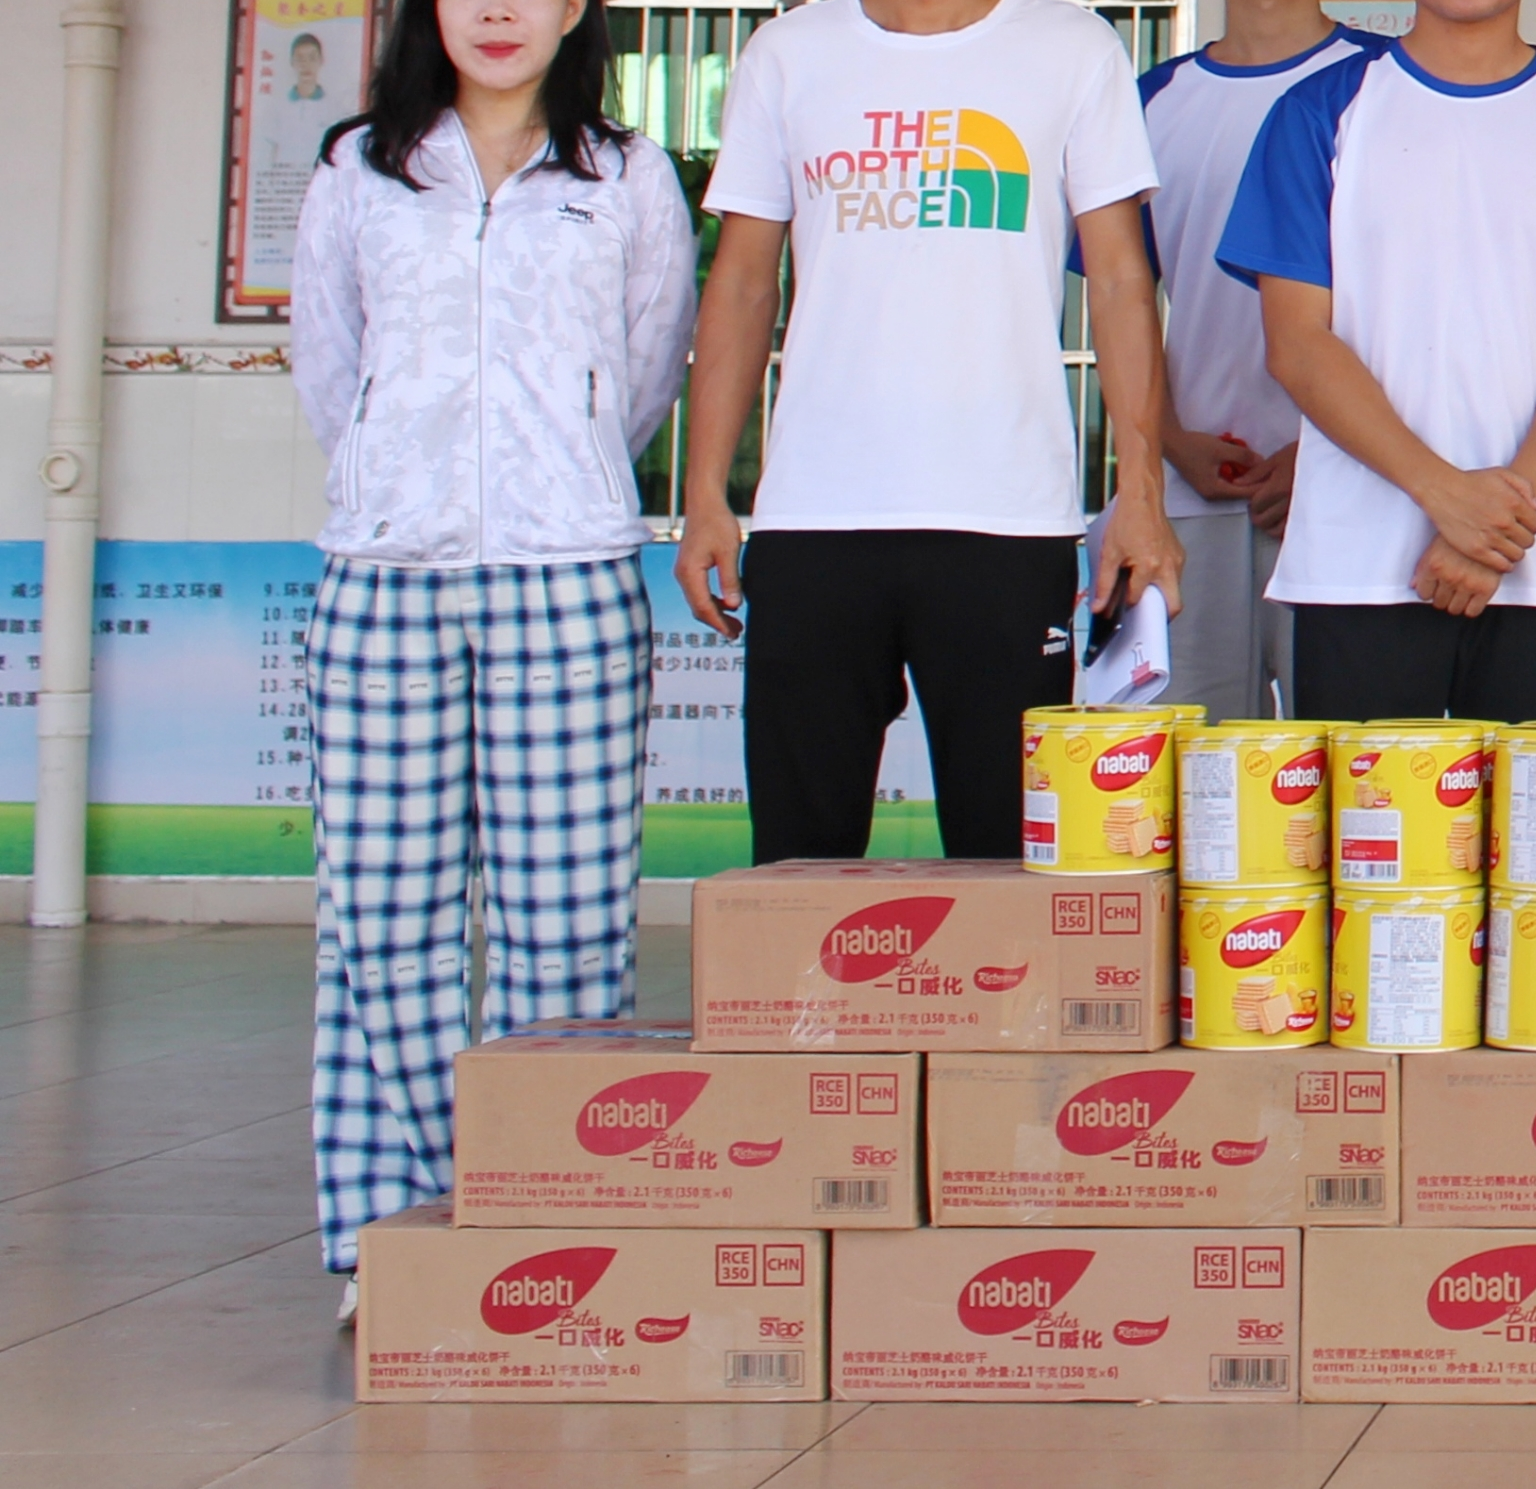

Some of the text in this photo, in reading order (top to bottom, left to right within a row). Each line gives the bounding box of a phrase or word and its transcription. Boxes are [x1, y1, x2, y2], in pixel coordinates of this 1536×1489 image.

[864, 110, 951, 148] THE
[803, 149, 950, 200] NORTH
[836, 190, 947, 232] FACE
[1097, 752, 1150, 774] nabati
[1058, 900, 1086, 914] RCE
[1105, 907, 1136, 919] CHN
[1058, 916, 1086, 928] 350
[831, 925, 912, 955] nabati
[1226, 929, 1281, 951] nabati
[874, 977, 963, 996] 一口威化
[816, 1080, 844, 1093] RCE
[862, 1086, 893, 1099] CHN
[1349, 1085, 1381, 1097] CHN
[816, 1096, 843, 1107] 350
[1303, 1094, 1330, 1106] 350
[587, 1102, 667, 1128] nabati
[1068, 1097, 1150, 1128] nabati
[629, 1151, 717, 1169] 一口威化
[1111, 1150, 1201, 1169] 一口威化
[722, 1252, 750, 1265] RCE
[768, 1258, 799, 1271] CHN
[1201, 1254, 1229, 1267] RCE
[1247, 1261, 1279, 1274] CHN
[722, 1267, 749, 1280] 350
[1201, 1270, 1228, 1282] 350
[492, 1276, 572, 1306] nabati
[969, 1277, 1051, 1308] nabati
[1438, 1272, 1521, 1303] nabati
[1012, 1331, 1102, 1349] 一口威化
